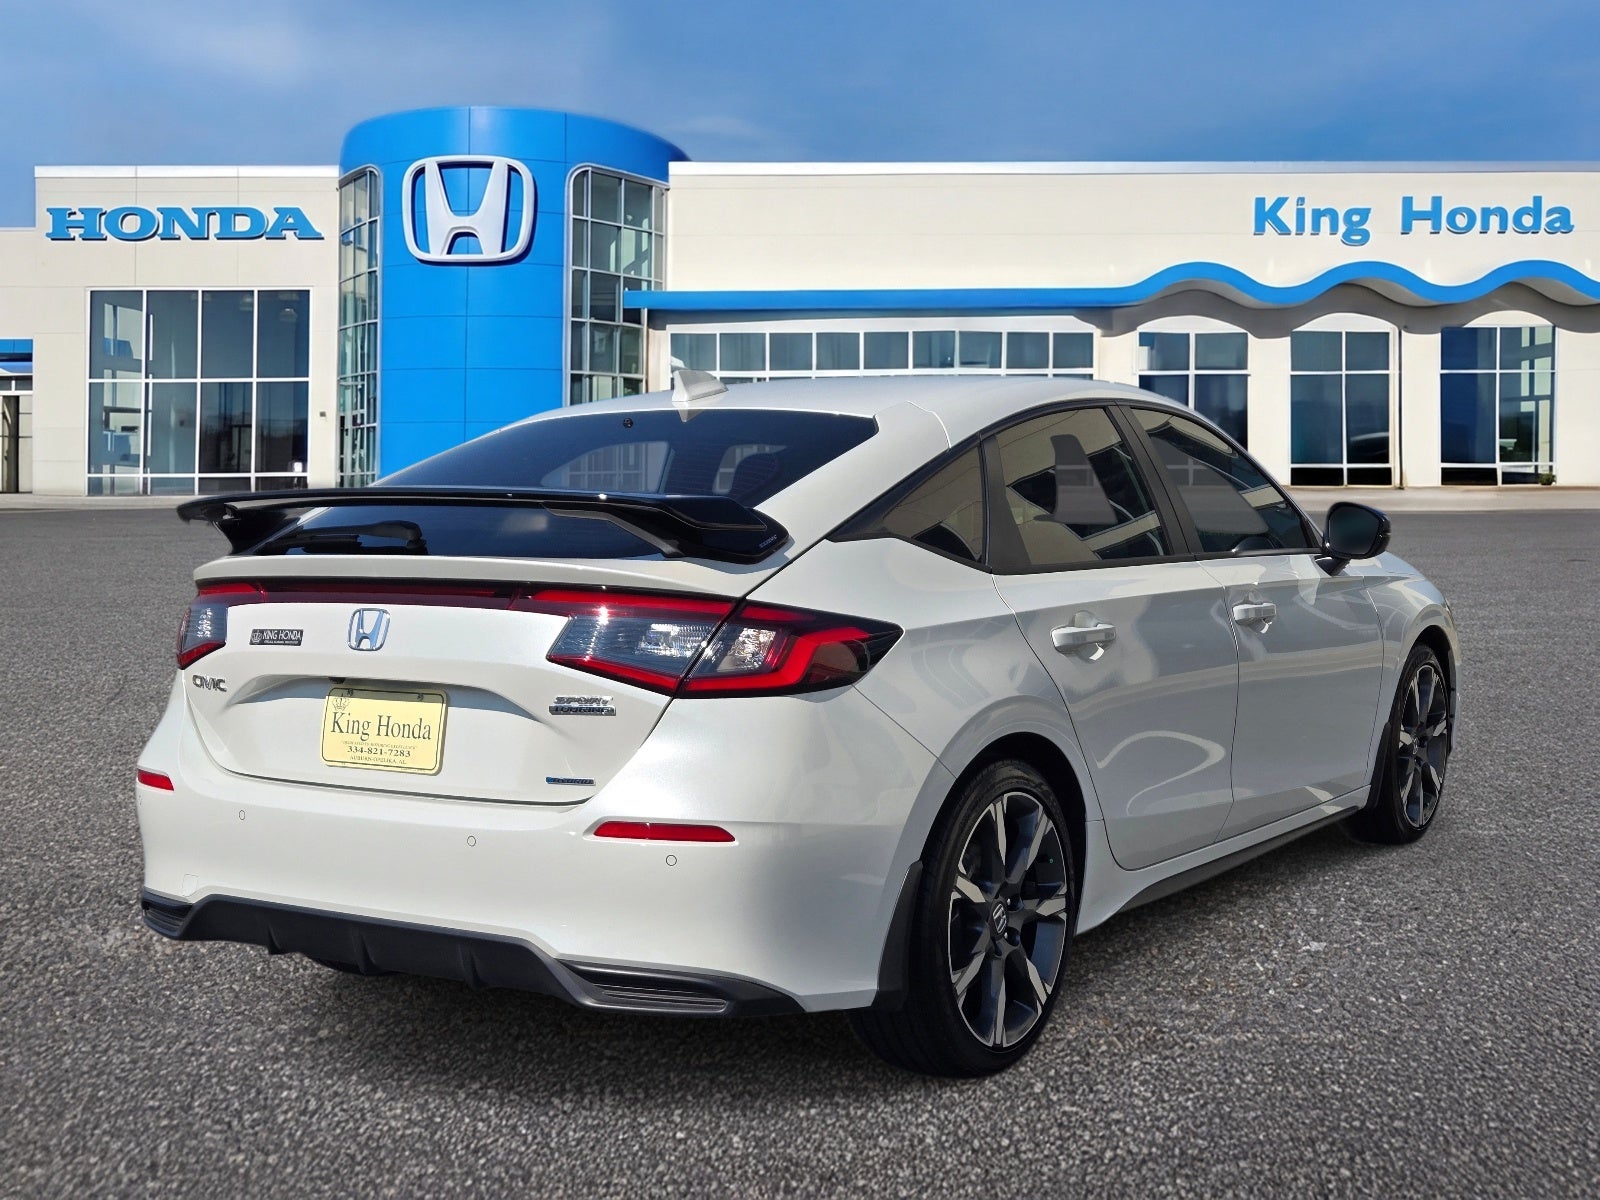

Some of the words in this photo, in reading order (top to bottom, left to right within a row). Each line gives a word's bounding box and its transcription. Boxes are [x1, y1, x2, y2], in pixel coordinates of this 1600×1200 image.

[46, 206, 325, 242] HONDA
[1253, 196, 1372, 246] King
[1400, 195, 1575, 234] Honda
[262, 630, 278, 640] KING
[278, 630, 302, 641] HONDA
[192, 674, 227, 692] CIVIC
[330, 711, 371, 741] King
[376, 714, 432, 740] Honda
[347, 745, 411, 757] 334-821-7283
